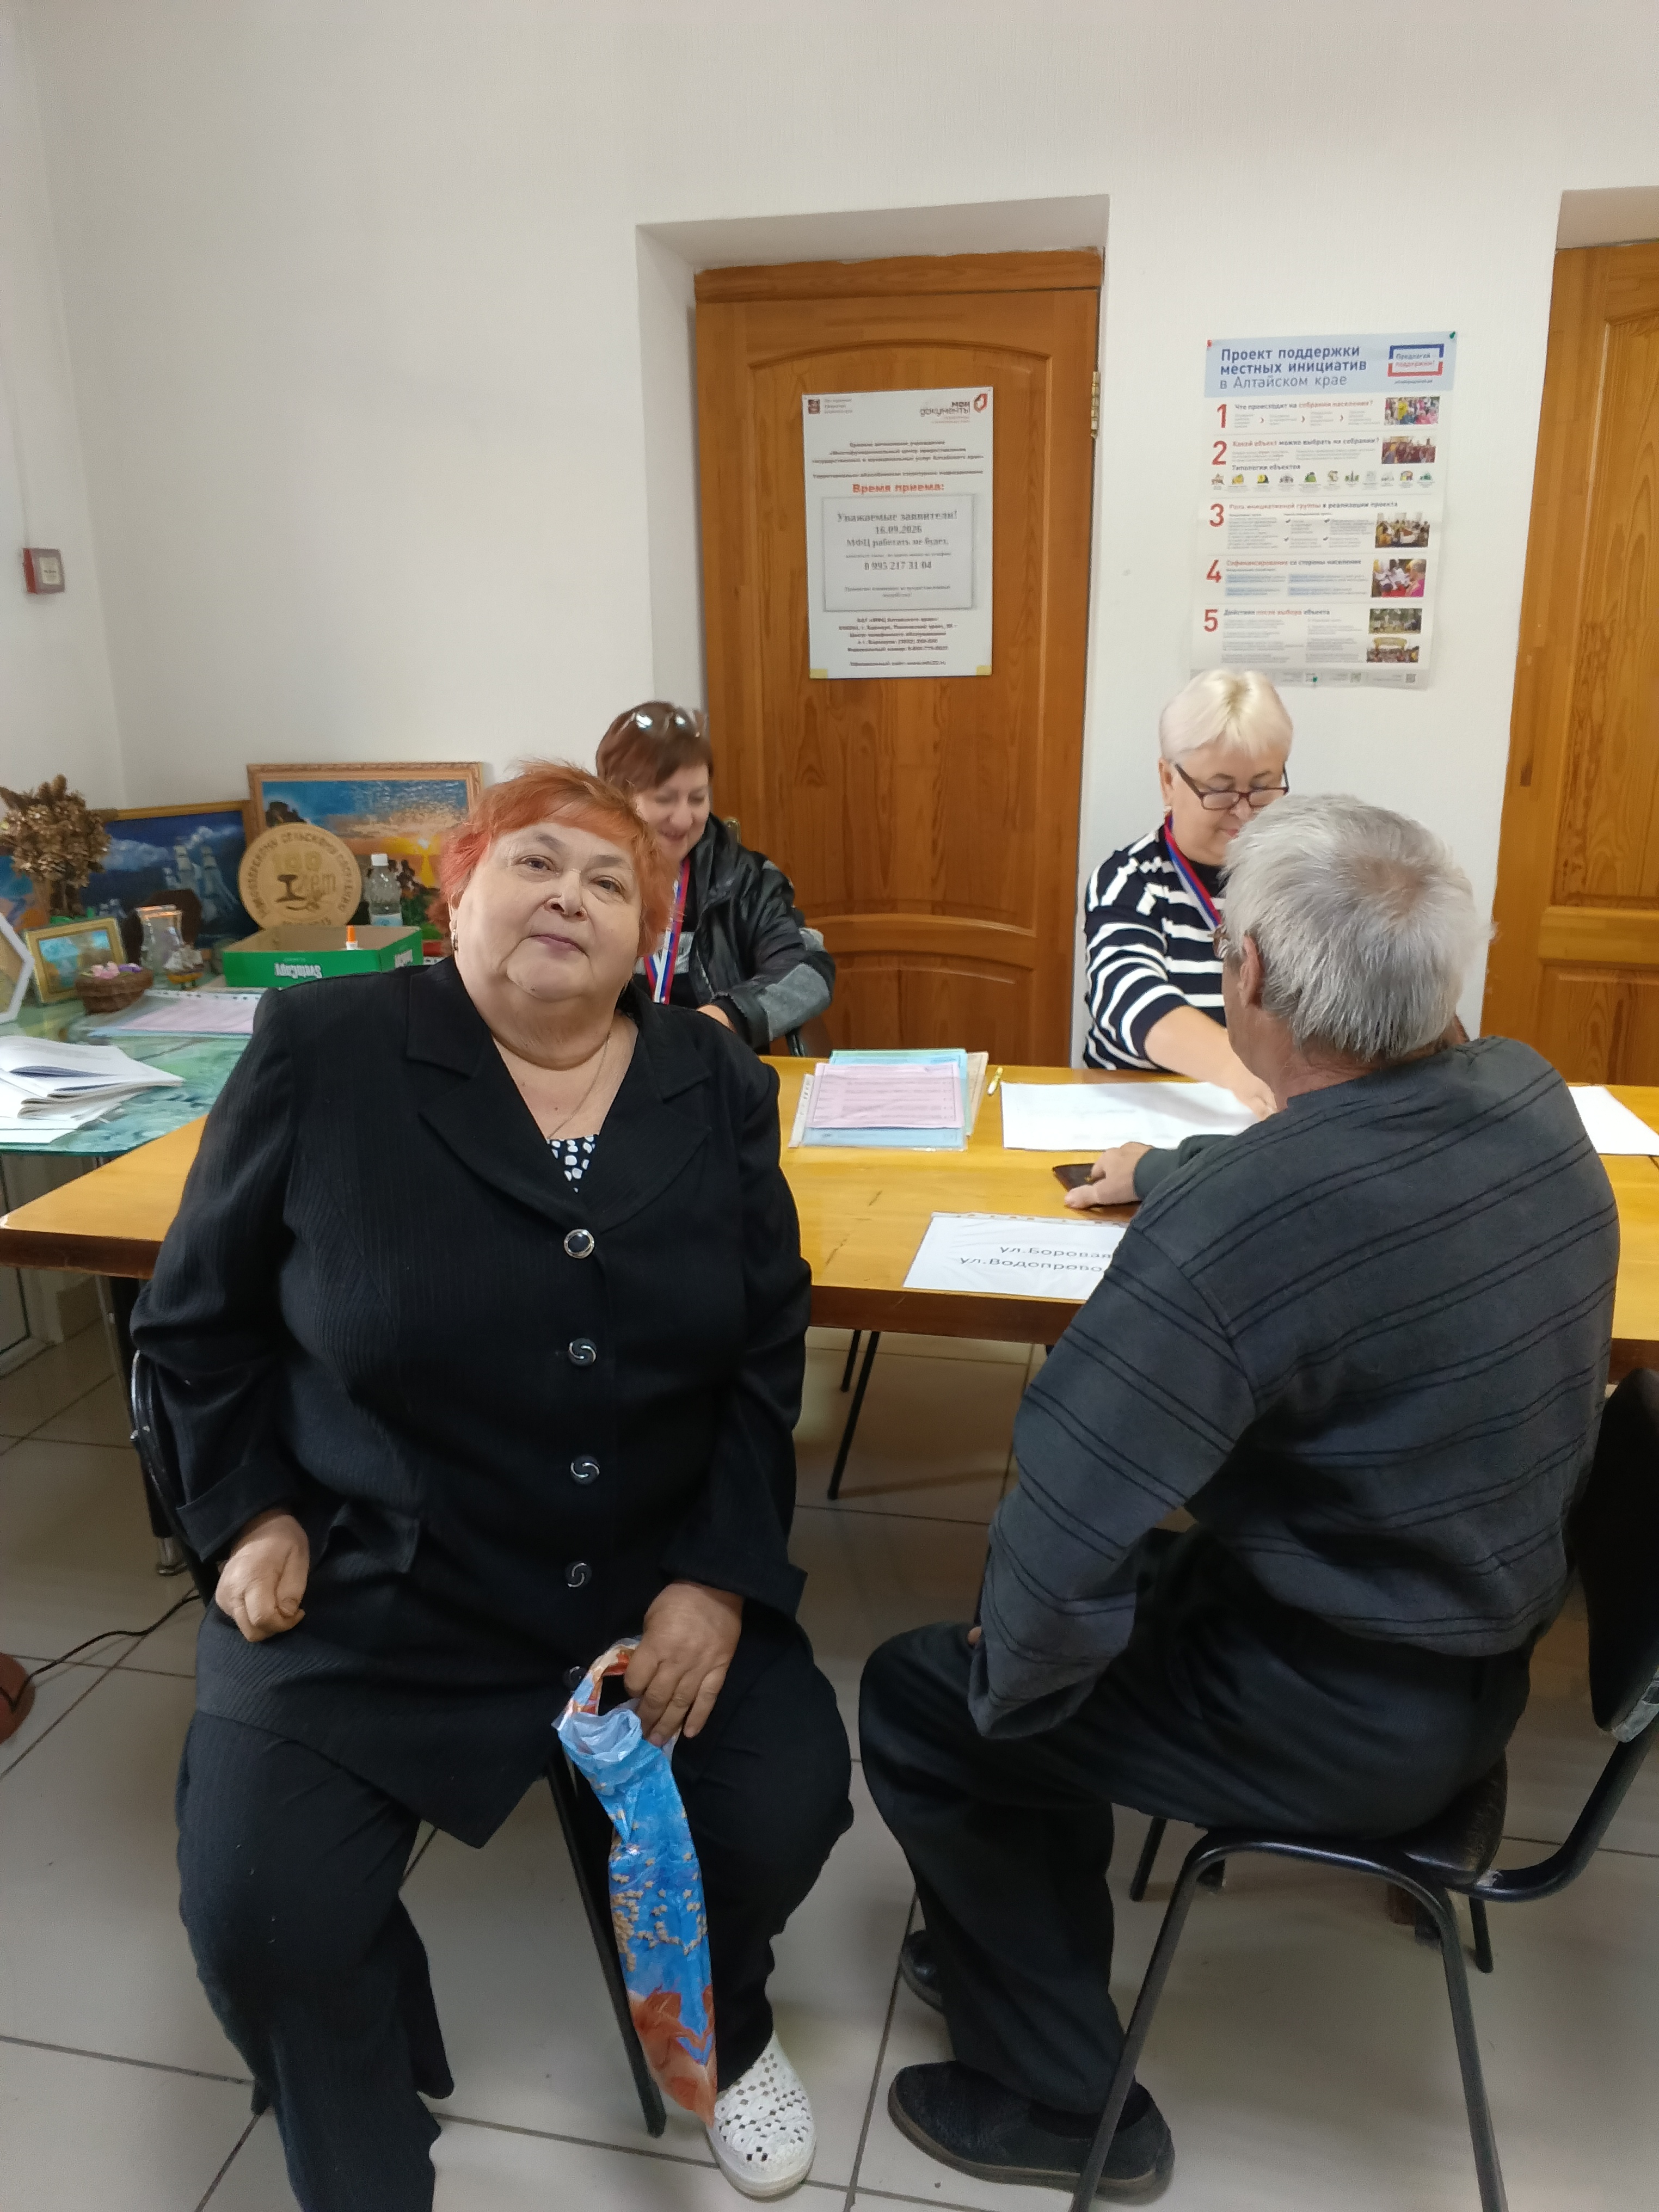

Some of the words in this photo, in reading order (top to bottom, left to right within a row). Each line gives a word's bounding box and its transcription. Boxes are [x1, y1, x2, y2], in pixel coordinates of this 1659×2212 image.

[1221, 348, 1272, 363] Проект
[1278, 345, 1360, 361] поддержки
[1220, 360, 1282, 376] местных
[1288, 360, 1367, 374] инициатив
[1220, 378, 1227, 389] в
[1233, 374, 1308, 389] Алтайском
[1315, 375, 1348, 388] крае
[1216, 403, 1227, 428] 1
[1212, 440, 1227, 465] 2
[852, 483, 891, 494] Время
[895, 483, 945, 494] приема:
[1209, 503, 1224, 527] 3
[1206, 559, 1222, 583] 4
[1204, 609, 1219, 632] 5
[960, 1257, 1104, 1273] ул.Водопрово
